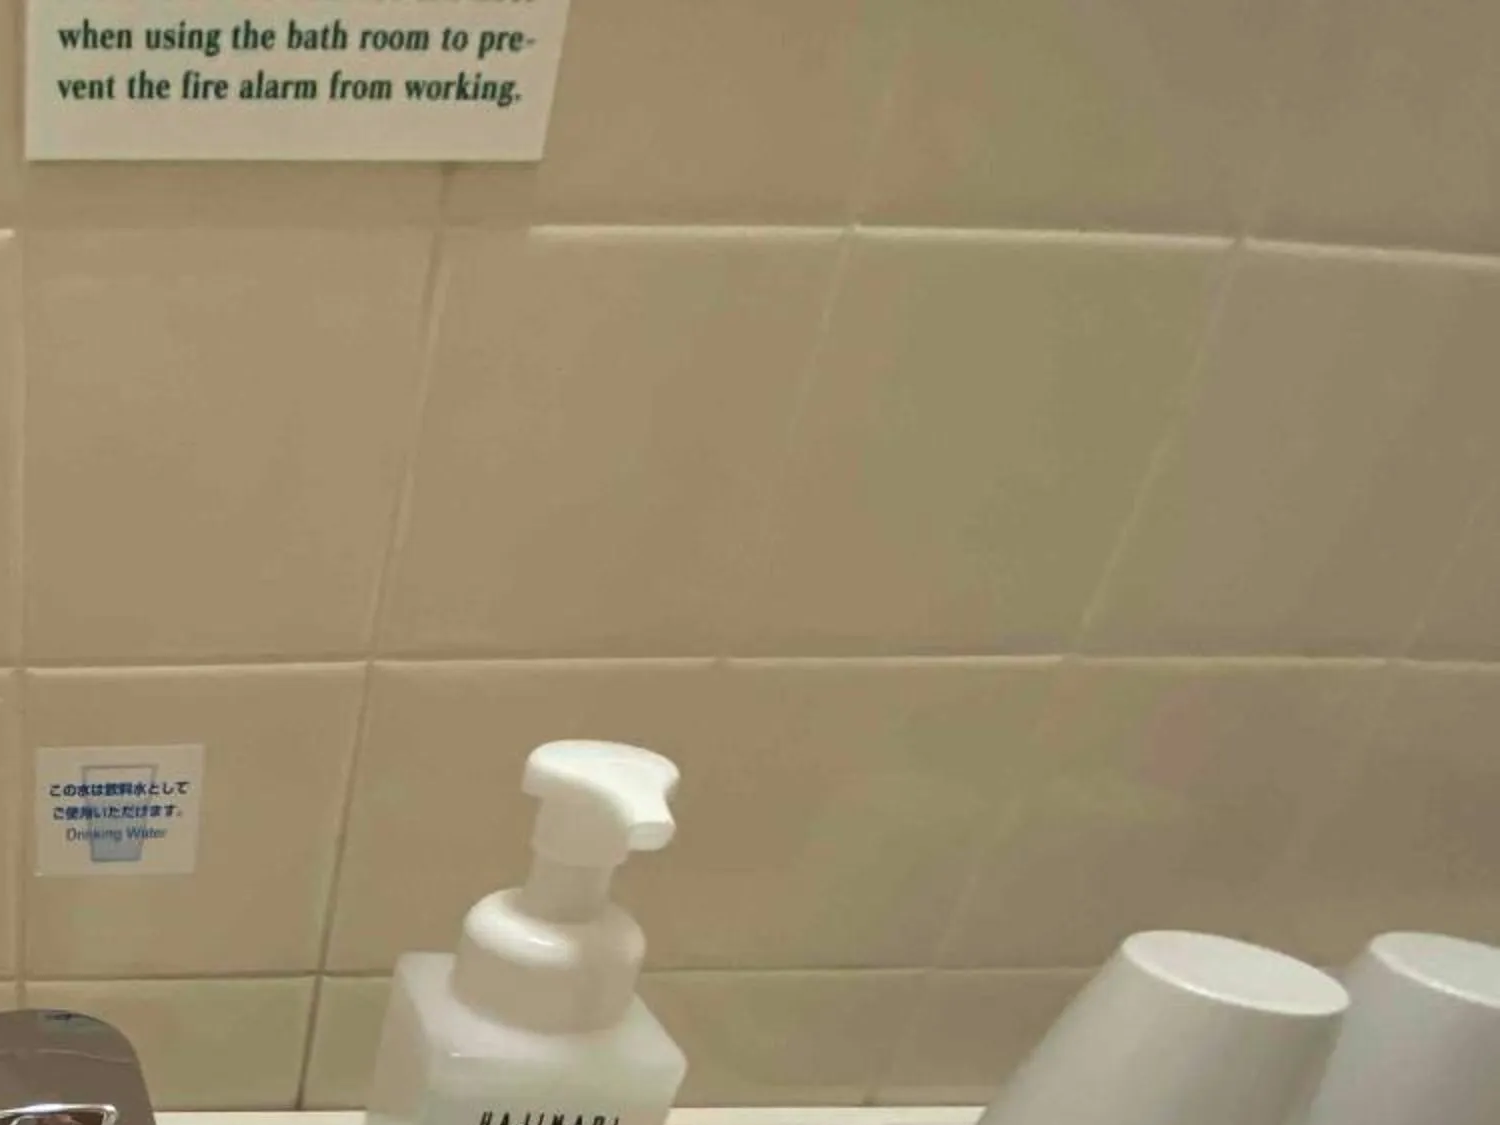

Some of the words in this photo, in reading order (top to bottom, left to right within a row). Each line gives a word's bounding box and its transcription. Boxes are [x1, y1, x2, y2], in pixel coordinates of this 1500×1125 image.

[57, 19, 133, 51] when
[144, 22, 221, 56] using
[231, 22, 276, 51] the
[286, 22, 349, 52] bath
[359, 28, 430, 52] room
[441, 26, 470, 52] to
[477, 30, 537, 60] pre-
[56, 75, 116, 101] vent
[127, 71, 171, 100] the
[182, 71, 229, 100] fire
[239, 71, 318, 100] alarm
[328, 71, 393, 101] from
[404, 73, 523, 107] working.
[65, 827, 122, 843] Drinking
[125, 826, 168, 840] Water
